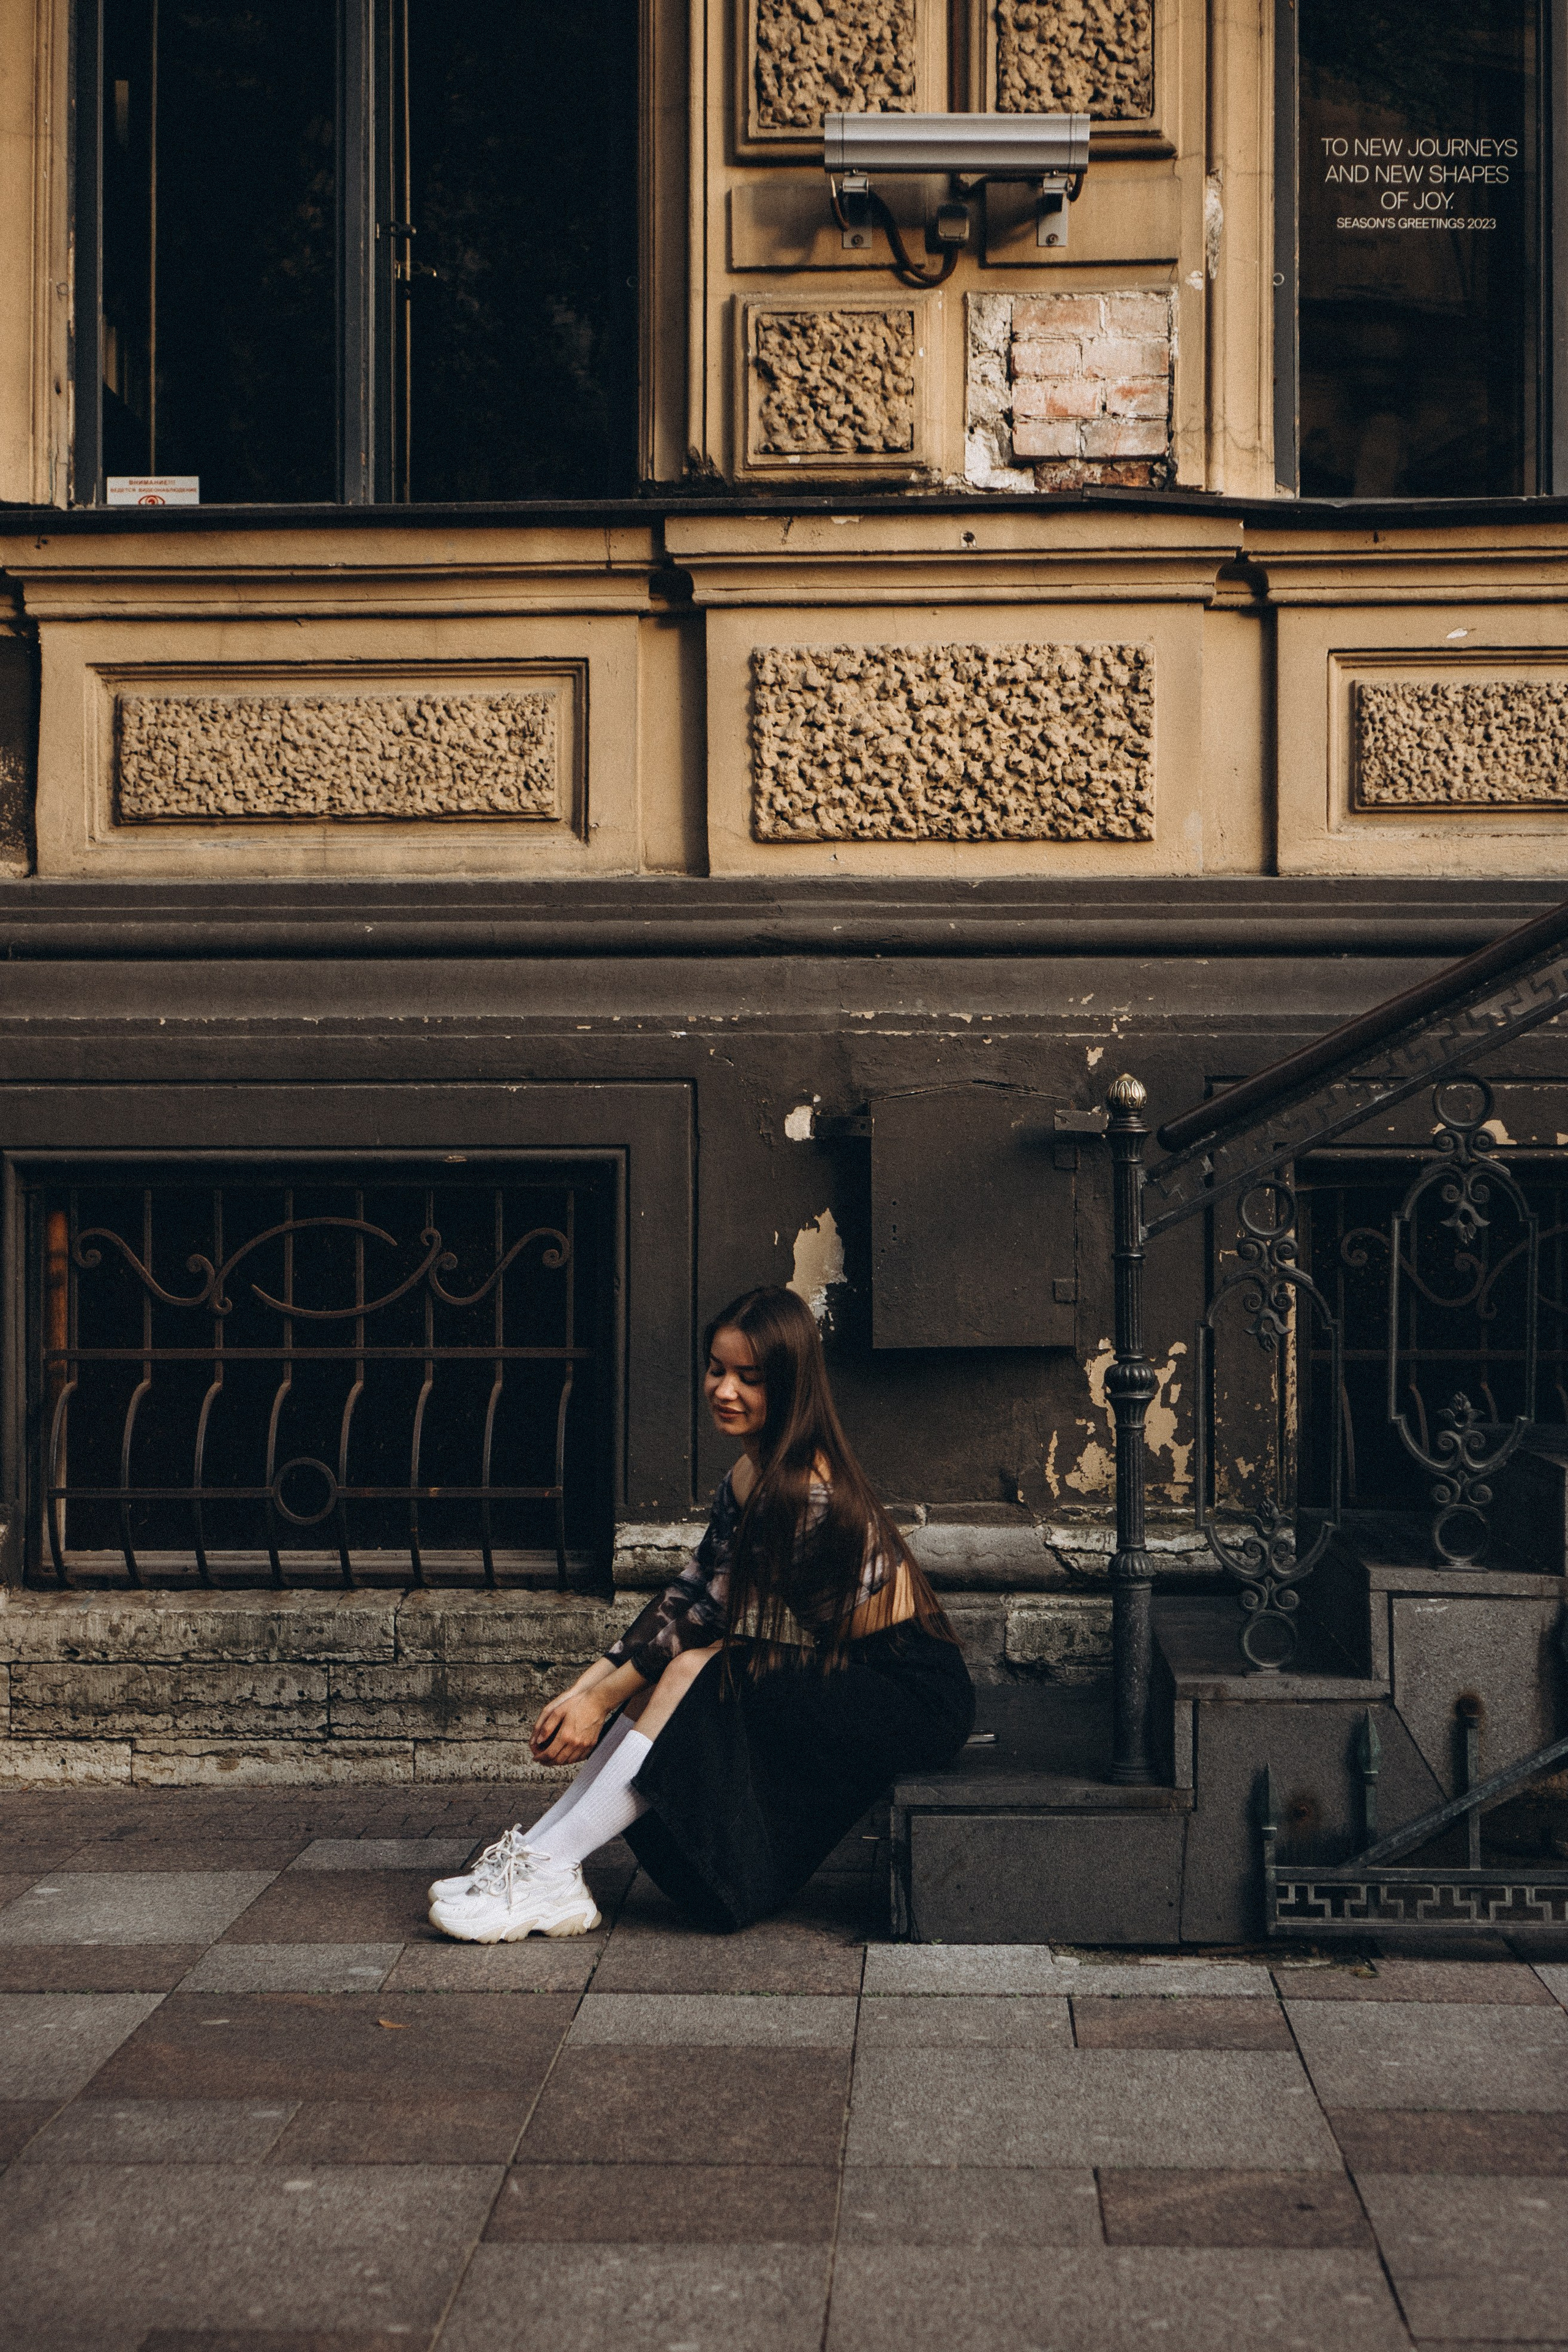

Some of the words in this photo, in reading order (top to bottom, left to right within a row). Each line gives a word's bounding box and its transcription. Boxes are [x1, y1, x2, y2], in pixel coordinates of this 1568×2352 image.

[1321, 138, 1348, 157] TO
[1355, 138, 1403, 157] NEW
[1408, 138, 1518, 157] JOURNEYS
[1325, 165, 1369, 183] AND
[1375, 165, 1423, 183] NEW
[1429, 165, 1509, 184] SHAPES
[1381, 191, 1409, 209] OF
[1413, 191, 1453, 209] JOY.
[1336, 217, 1395, 229] SEASON'S
[1398, 217, 1464, 229] GREETINGS
[1467, 217, 1496, 229] 2023
